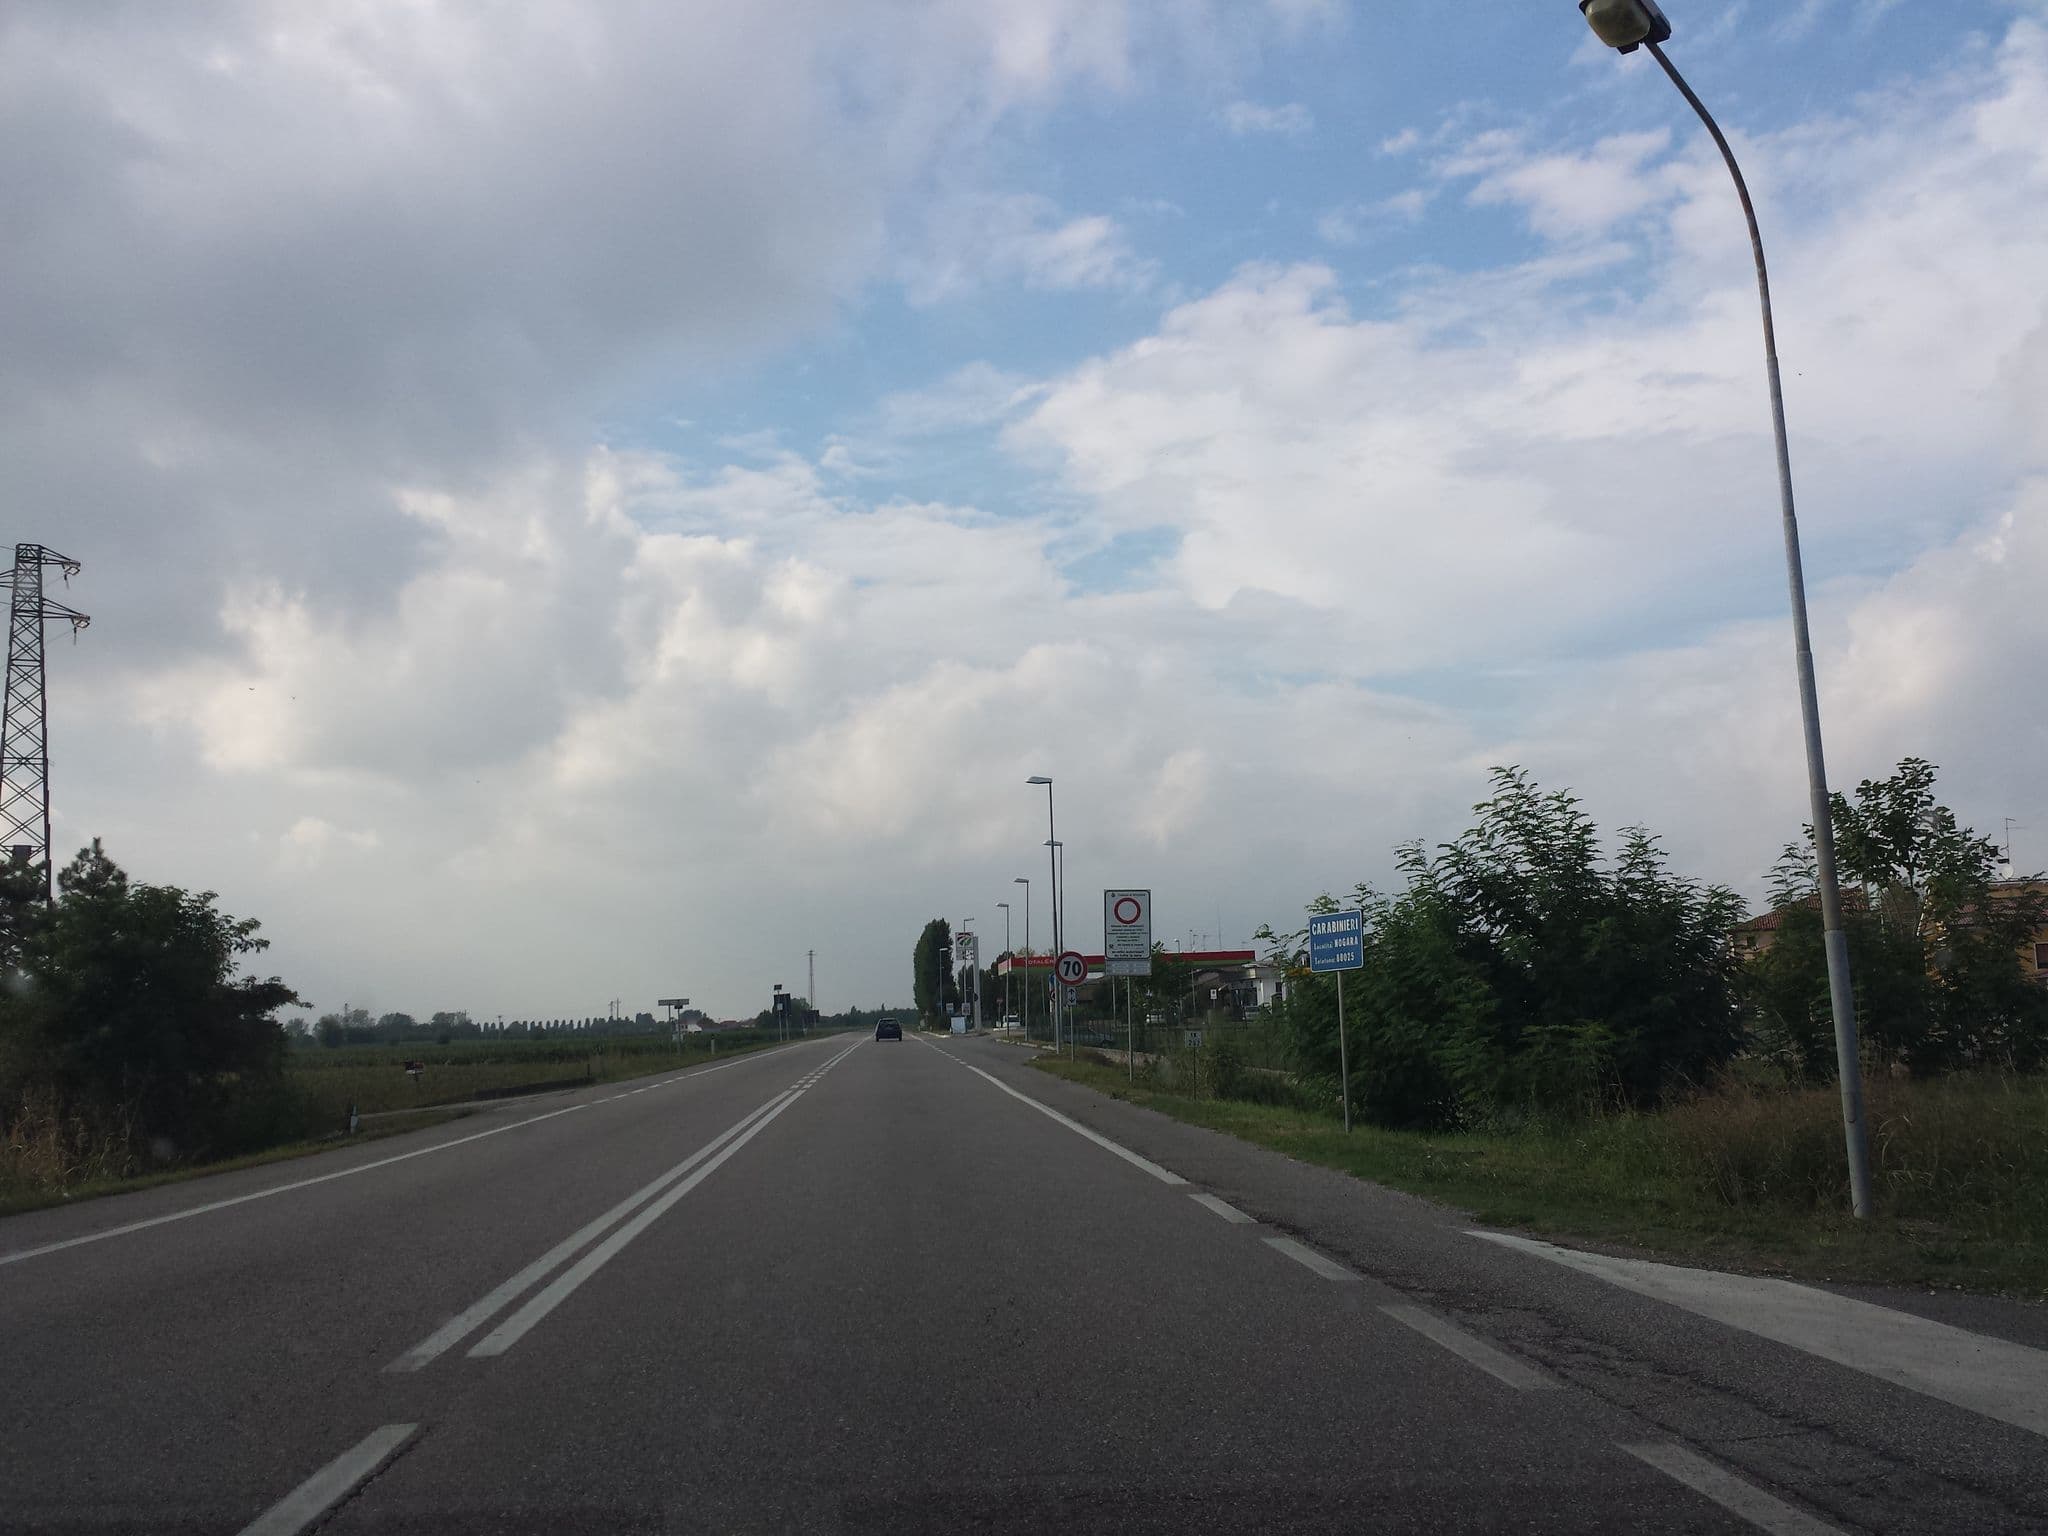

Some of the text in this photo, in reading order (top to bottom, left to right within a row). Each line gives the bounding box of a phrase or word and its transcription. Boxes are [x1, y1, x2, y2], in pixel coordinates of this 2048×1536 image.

[1312, 918, 1358, 935] CARABINIERI
[1334, 936, 1358, 948] NOGARA
[1063, 960, 1082, 977] 70
